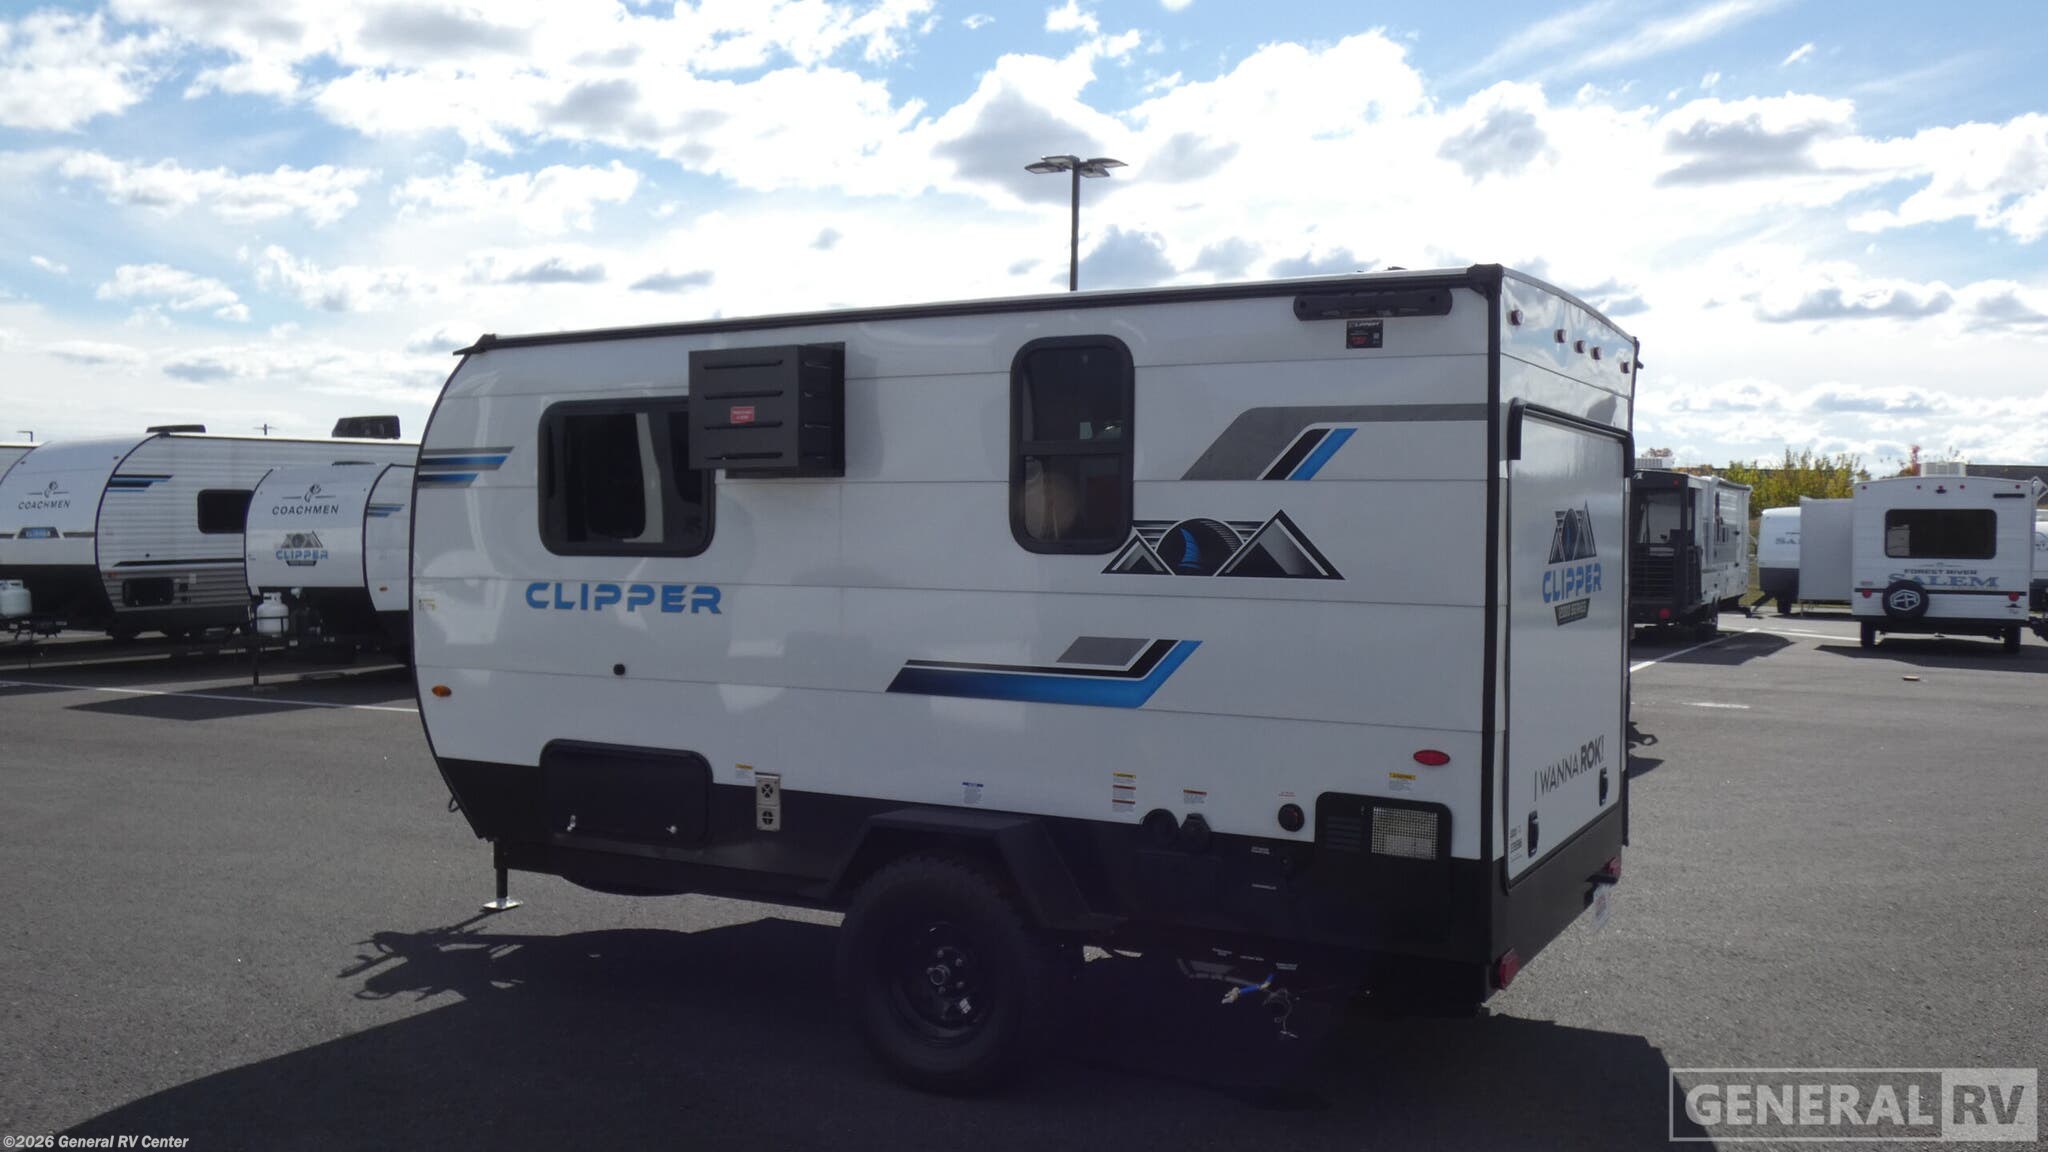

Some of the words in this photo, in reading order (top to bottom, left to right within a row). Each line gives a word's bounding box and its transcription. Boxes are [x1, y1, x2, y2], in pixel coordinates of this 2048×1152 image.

[18, 500, 71, 510] COACHMEN
[272, 504, 339, 515] COACHMEN
[275, 549, 329, 561] CLIPPER
[1542, 563, 1602, 603] CLIPPER
[525, 582, 722, 614] CLIPPER
[1540, 753, 1579, 795] WANNA
[1580, 735, 1604, 773] ROK!
